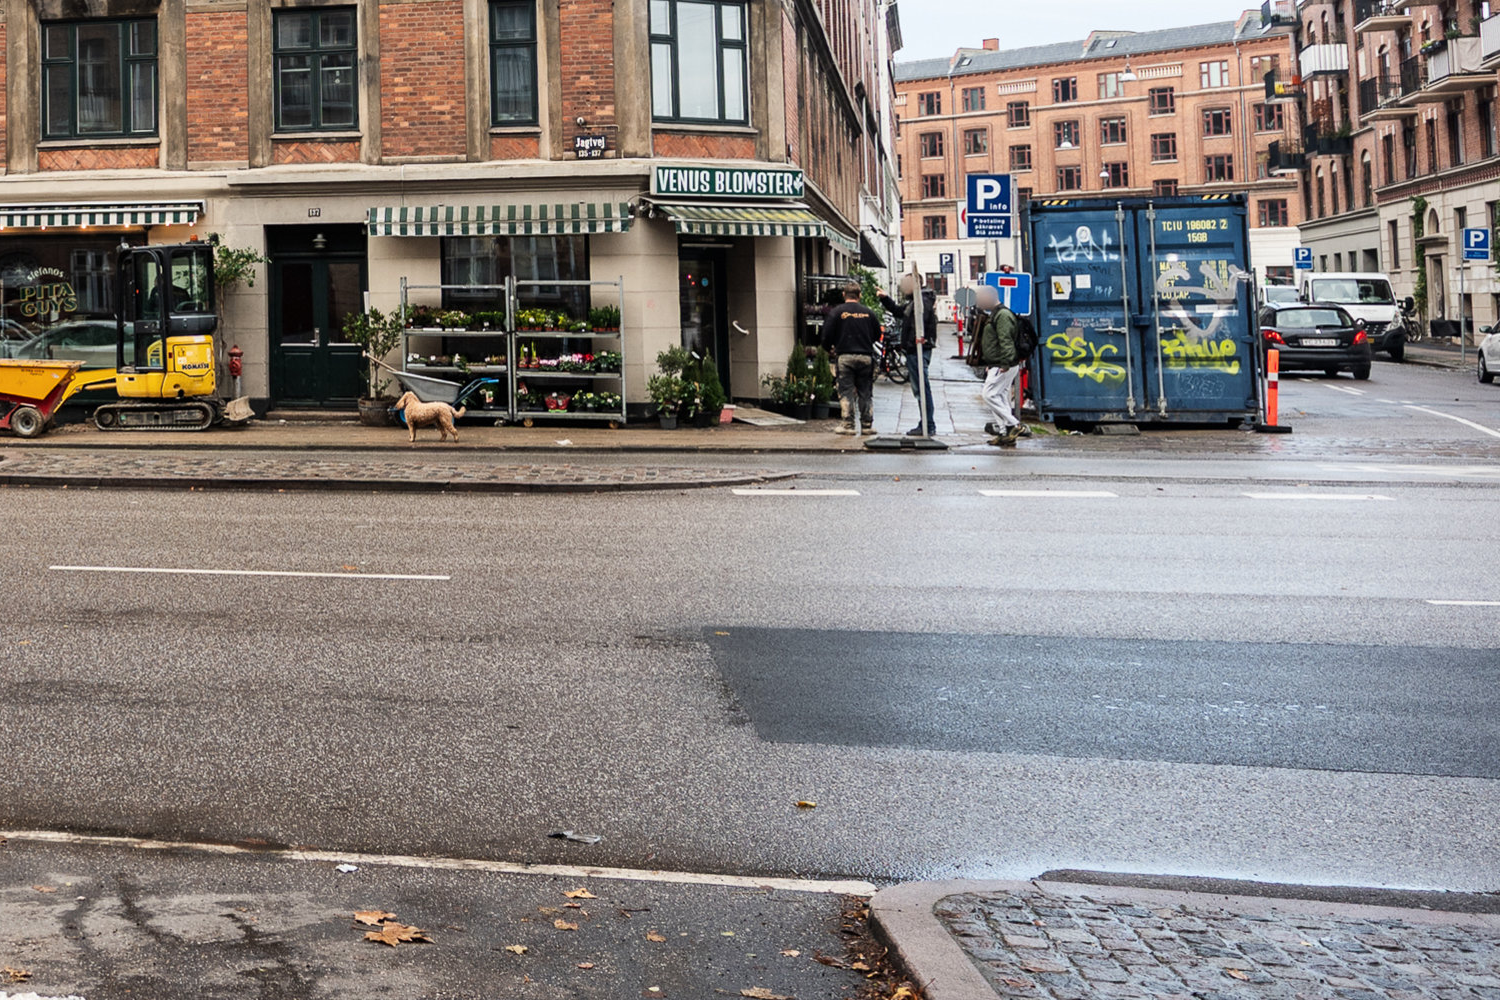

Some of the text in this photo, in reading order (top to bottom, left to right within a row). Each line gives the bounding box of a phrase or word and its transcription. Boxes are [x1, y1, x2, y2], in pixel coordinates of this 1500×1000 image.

[575, 136, 605, 149] Jagtvej
[657, 168, 794, 195] VENUS BLOMSTER
[976, 178, 1002, 211] P
[1161, 221, 1183, 231] TCIU
[1470, 230, 1485, 247] P
[942, 254, 951, 266] P
[1299, 249, 1309, 260] P
[20, 282, 76, 301] PITA
[20, 297, 77, 317] GUYS
